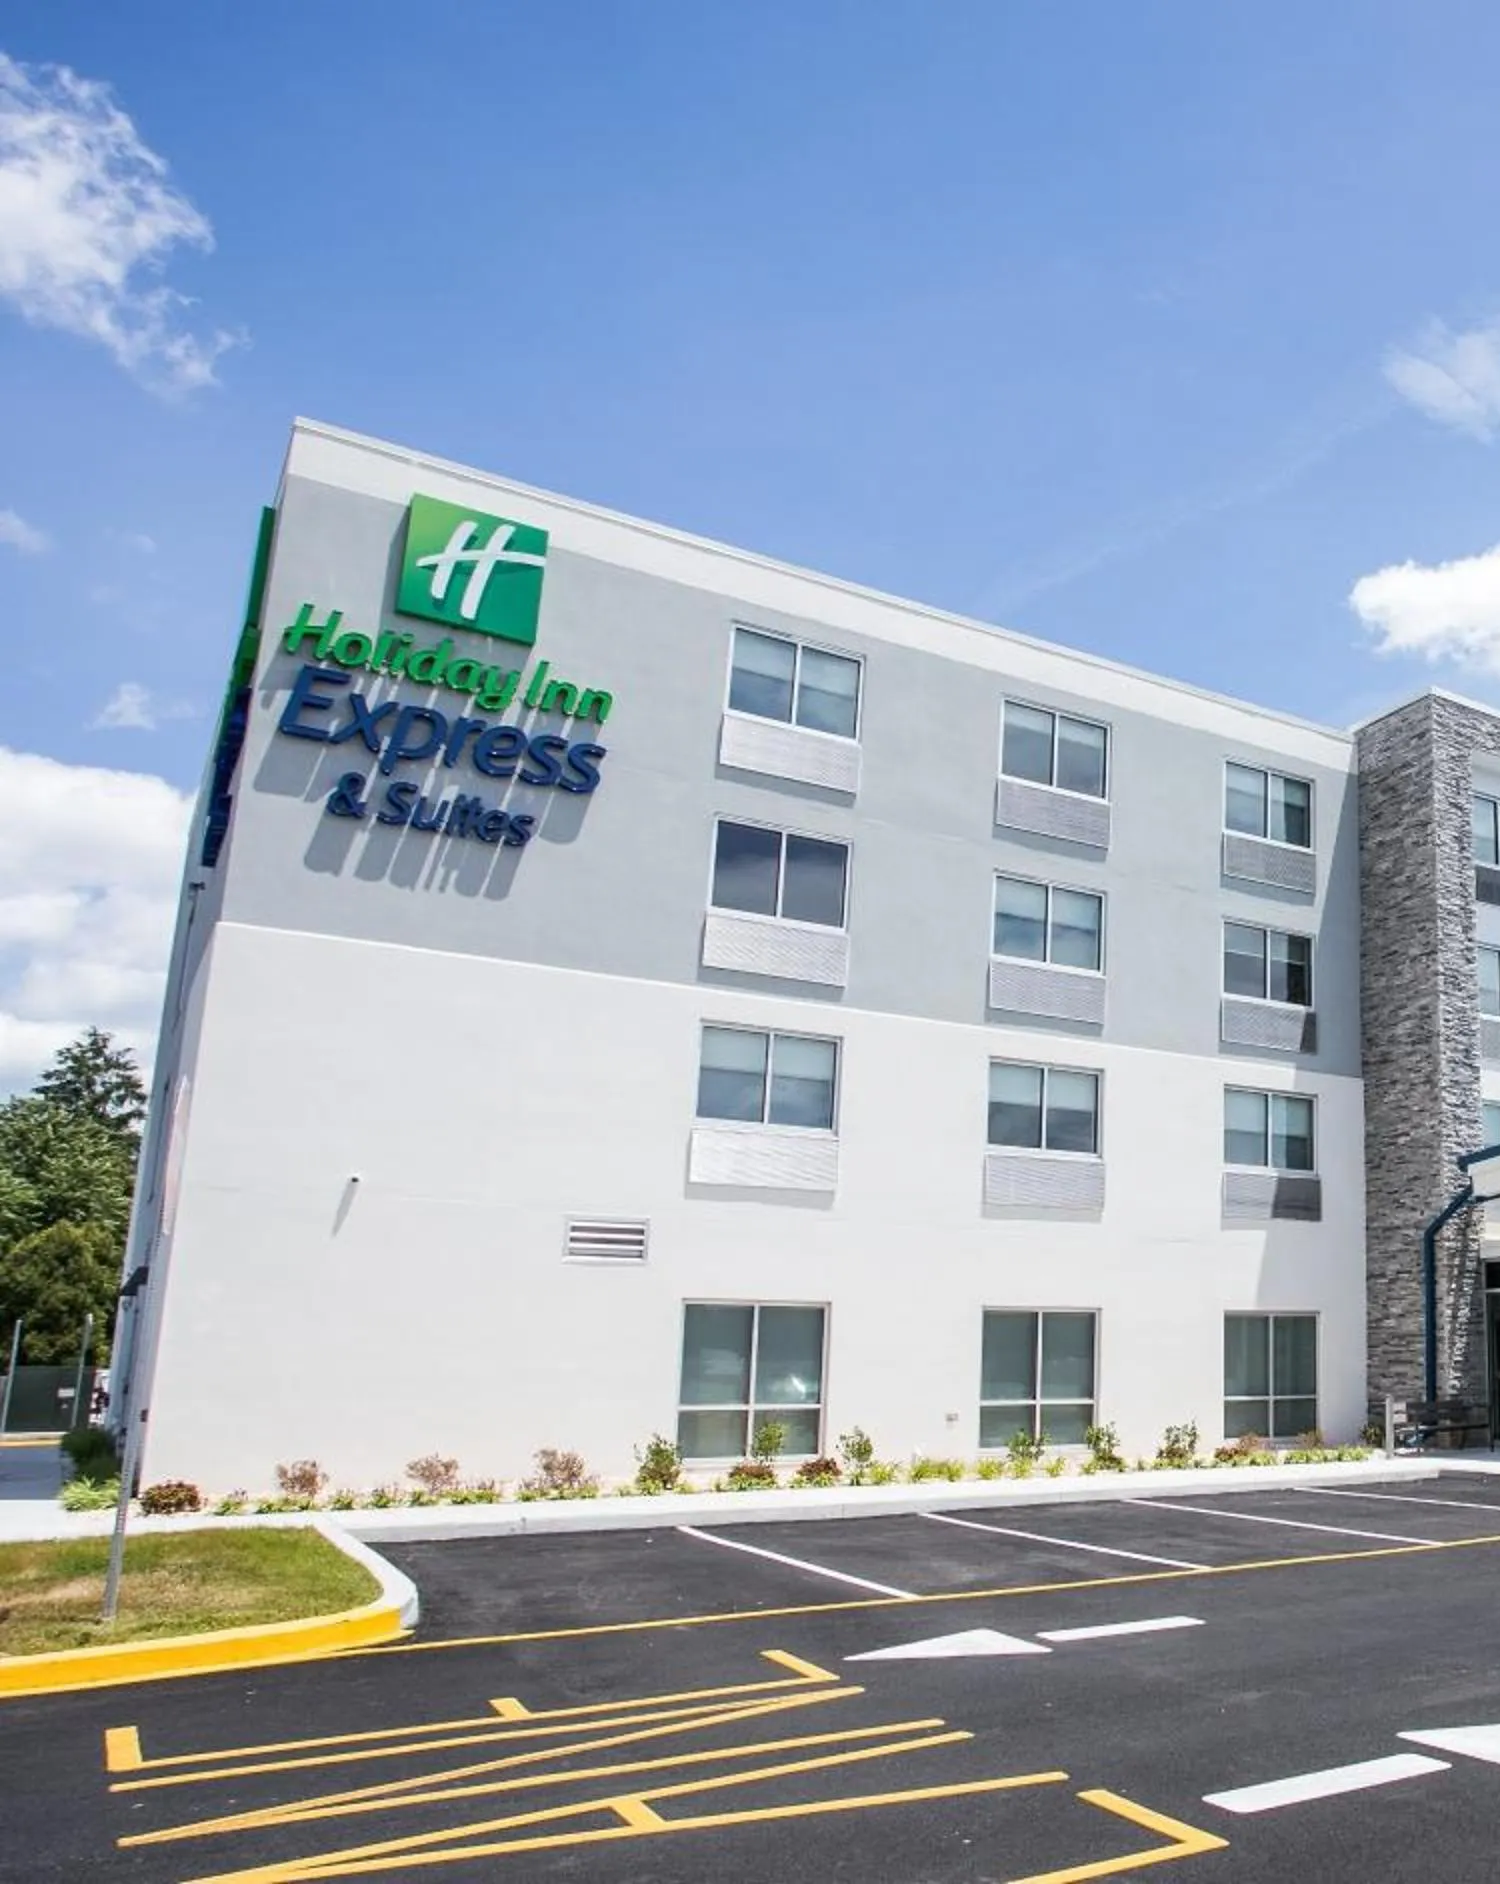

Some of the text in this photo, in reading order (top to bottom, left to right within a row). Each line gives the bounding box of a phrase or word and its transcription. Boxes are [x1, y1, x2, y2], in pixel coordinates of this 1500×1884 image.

[284, 603, 614, 725] Holiday Inn
[279, 665, 607, 794] Express
[327, 772, 536, 848] & Suites
